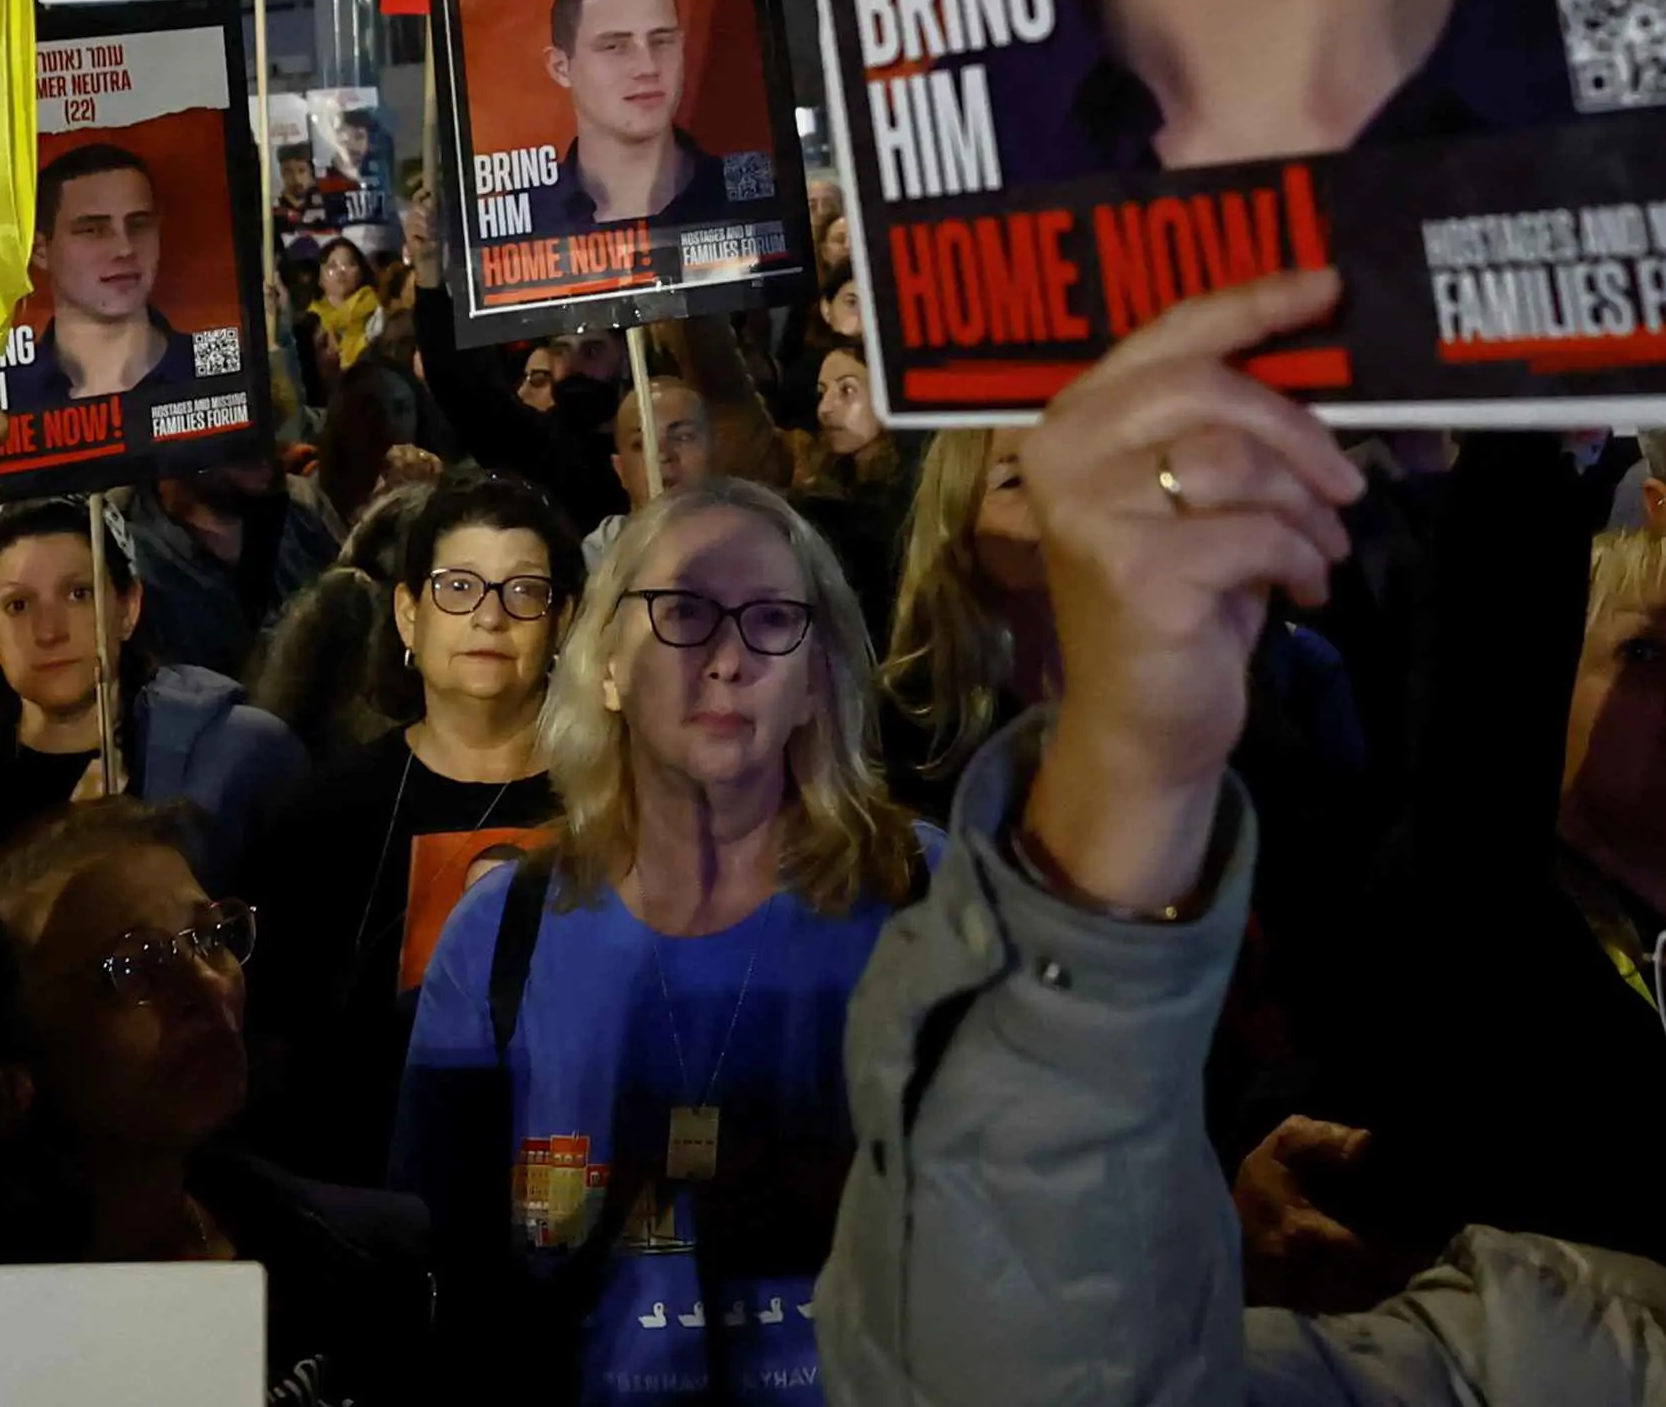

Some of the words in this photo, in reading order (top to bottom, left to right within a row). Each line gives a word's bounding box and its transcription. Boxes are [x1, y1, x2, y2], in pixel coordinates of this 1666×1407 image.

[36, 49, 83, 73] נאוטר
[86, 44, 123, 68] עומר
[36, 75, 67, 100] MER
[71, 69, 132, 96] NEUTRA
[65, 97, 95, 124] (22)
[866, 66, 1004, 201] HIM
[474, 145, 559, 195] BRING
[477, 194, 532, 239] HIM
[482, 237, 563, 288] HOME
[569, 221, 652, 277] NOW!
[683, 240, 738, 267] FAMILIES
[741, 234, 787, 257] FORUM
[889, 210, 1090, 348] HOME
[1093, 164, 1330, 337] NOW!
[1434, 260, 1633, 345] FAMILIES
[43, 395, 125, 449] NOW!
[151, 400, 193, 419] HOSTAGES
[194, 398, 211, 412] AND
[153, 412, 205, 438] FAMILIES
[207, 405, 249, 429] FORUM
